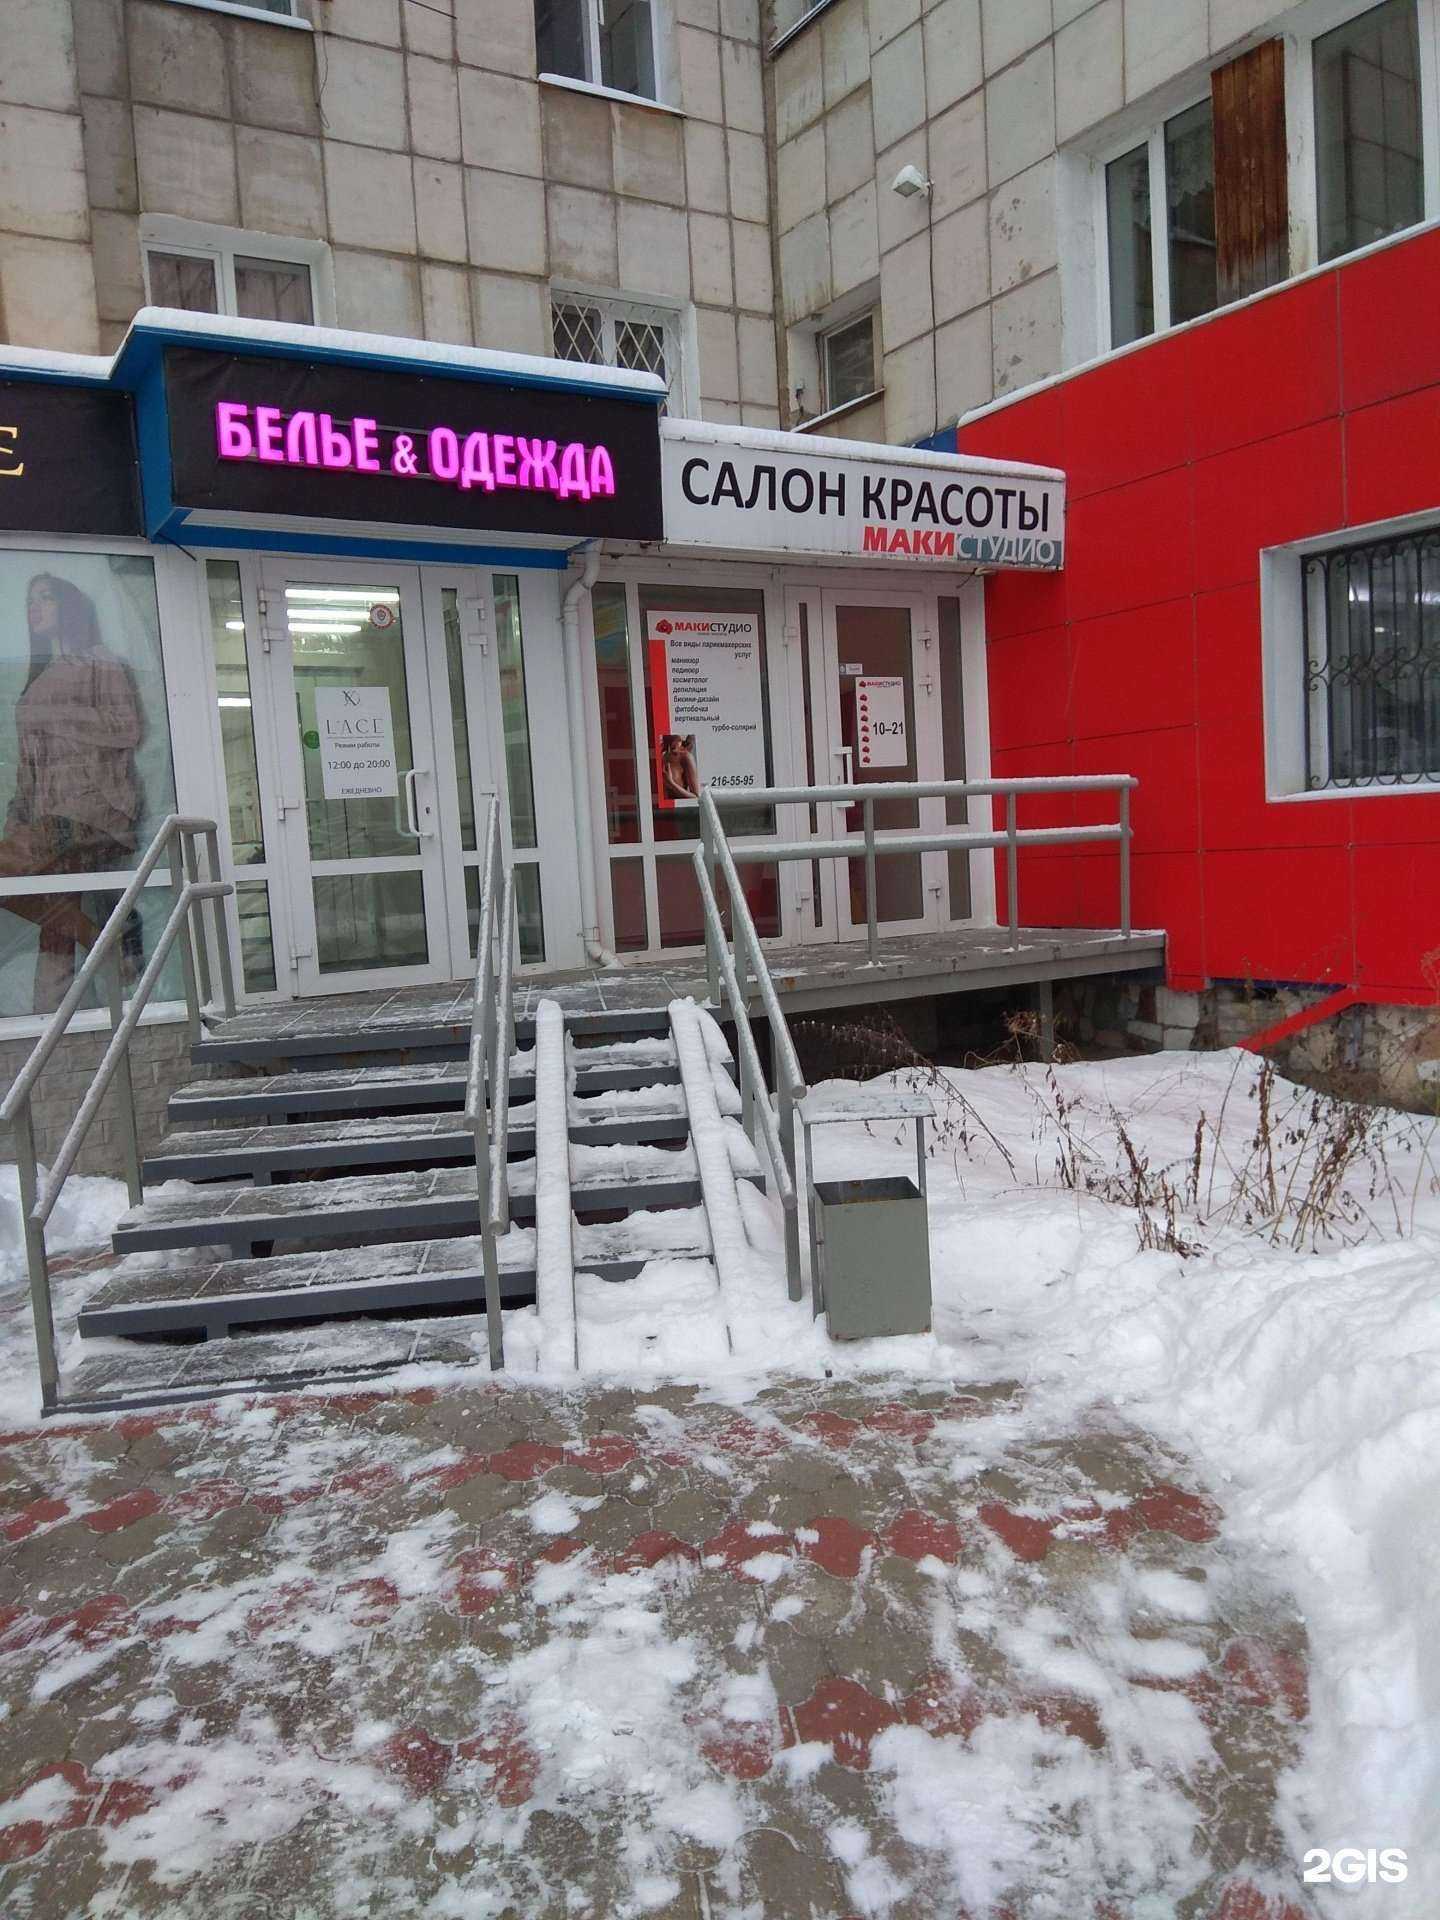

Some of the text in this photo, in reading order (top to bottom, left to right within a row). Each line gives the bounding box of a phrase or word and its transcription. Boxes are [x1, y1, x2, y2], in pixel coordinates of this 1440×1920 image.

[217, 402, 616, 499] БЕЛЬЕ & ОДЕЖДА
[681, 457, 1049, 533] САЛОН КРАСОТЫ
[674, 622, 752, 634] МАКИСТУДИО
[670, 640, 682, 648] Все
[684, 641, 700, 649] виды
[734, 652, 752, 660] услуг
[328, 760, 391, 770] 12:00 до 20:00
[711, 775, 754, 787] 216-55-95
